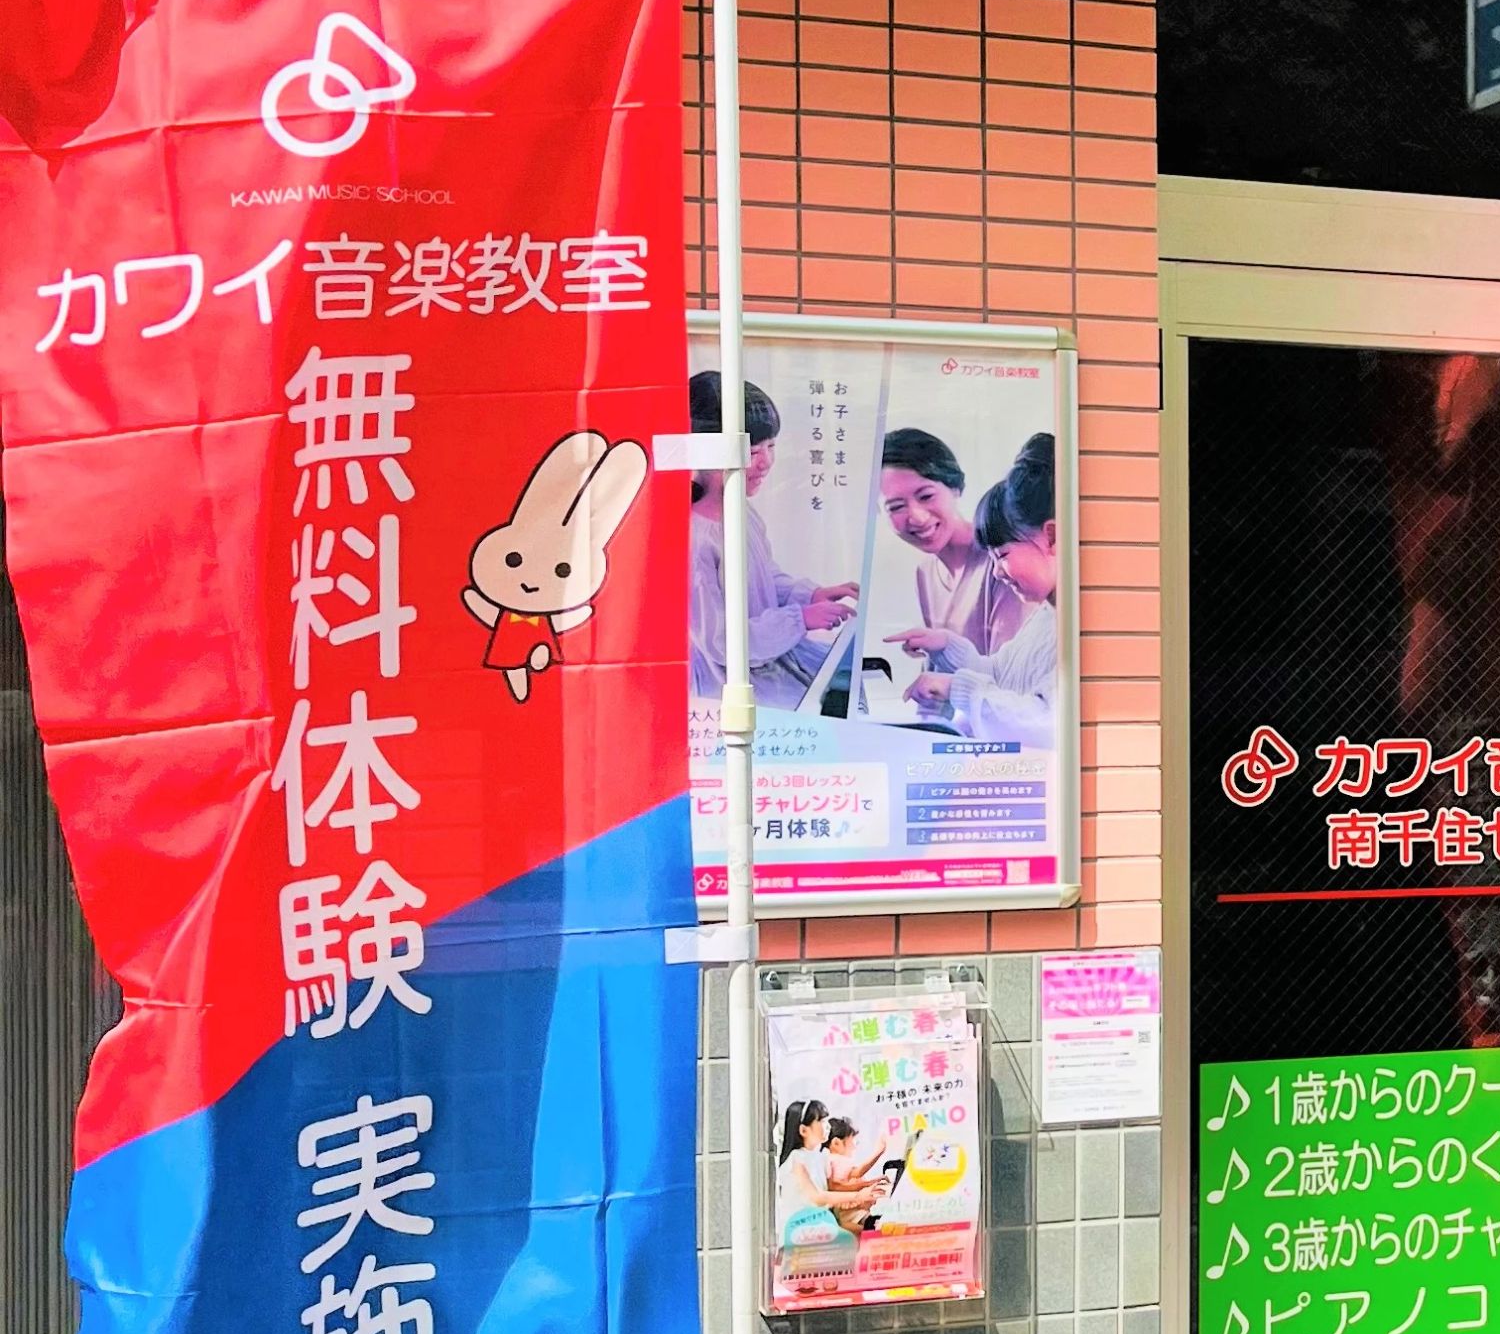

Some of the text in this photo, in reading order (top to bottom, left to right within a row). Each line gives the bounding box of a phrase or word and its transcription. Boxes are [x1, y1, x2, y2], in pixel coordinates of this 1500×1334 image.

[230, 183, 456, 208] KAWAI MUSIC SCHOOL
[35, 230, 652, 353] カワイ音楽教室
[809, 379, 825, 511] 弾ける喜びを
[833, 380, 849, 487] お子さまに
[887, 1104, 967, 1136] PIANO
